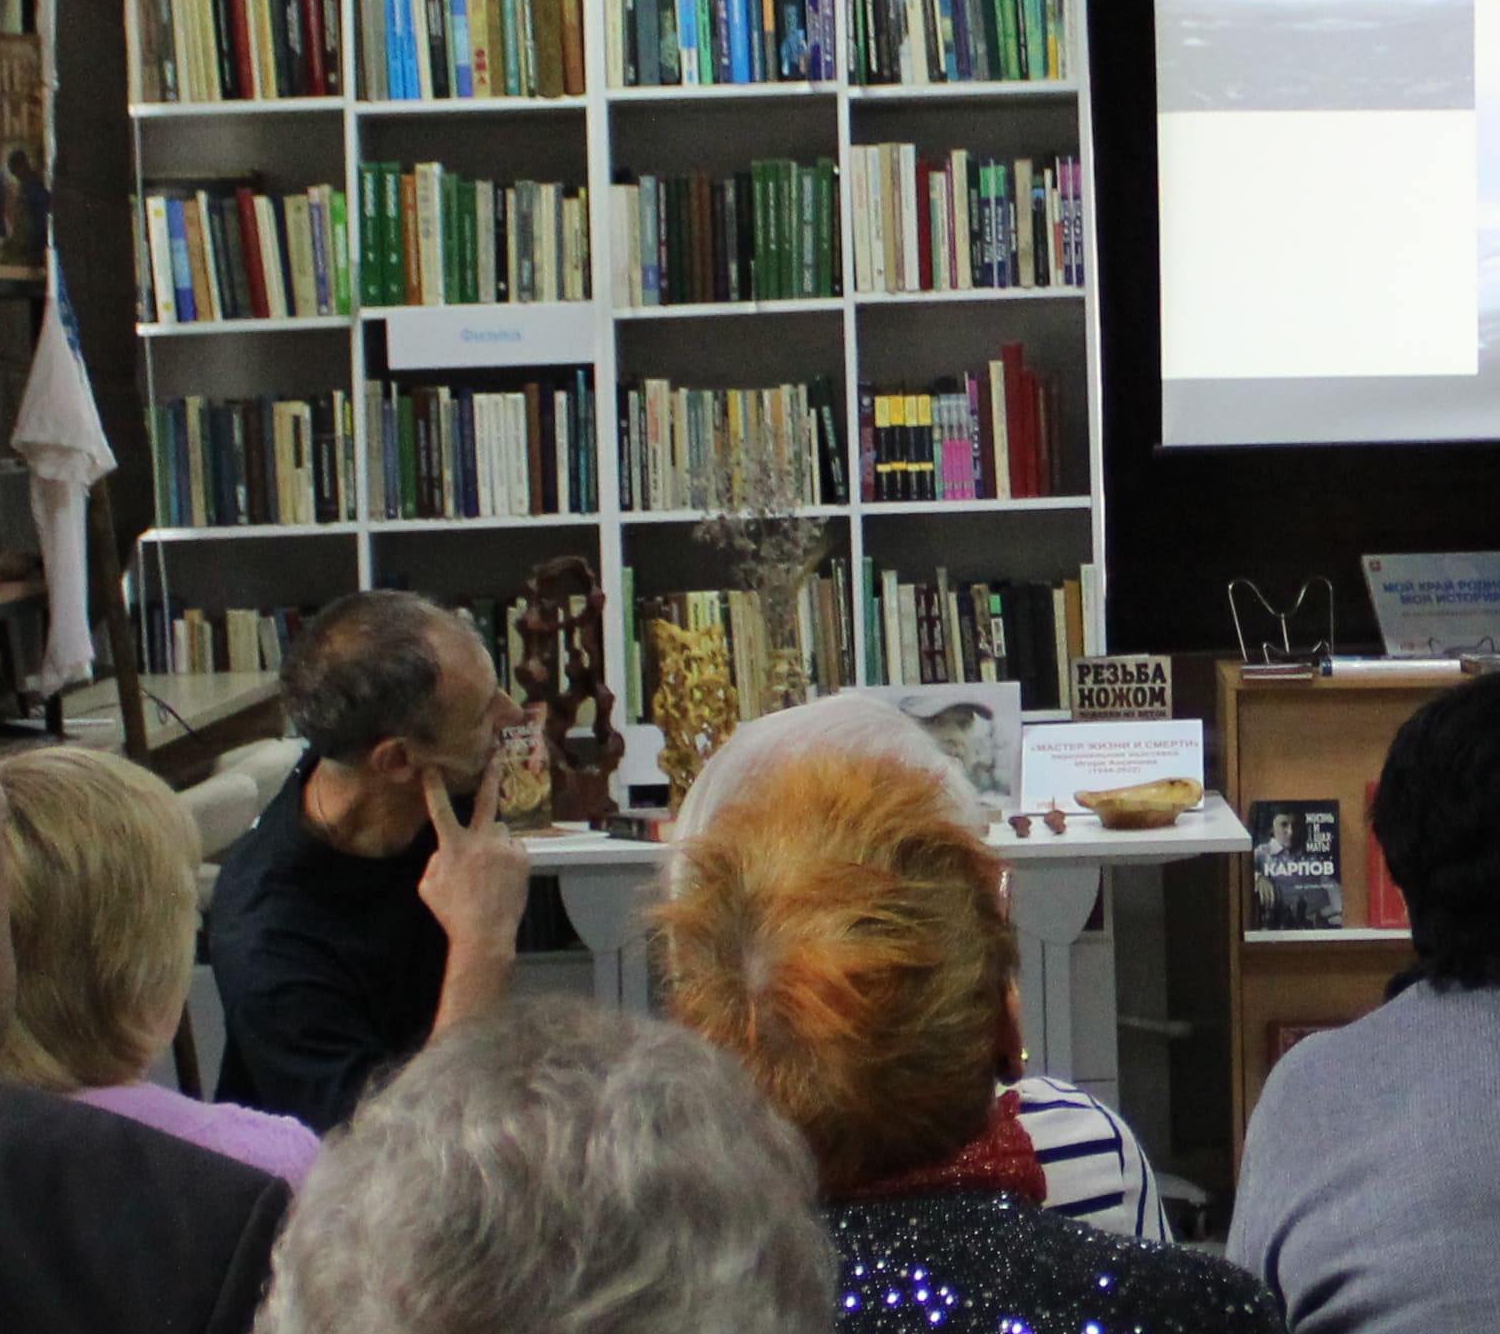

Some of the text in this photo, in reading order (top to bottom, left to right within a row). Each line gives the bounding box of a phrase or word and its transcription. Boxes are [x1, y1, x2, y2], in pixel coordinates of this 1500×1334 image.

[1382, 579, 1414, 593] МОЙ
[1418, 579, 1454, 592] КРАЙ
[1077, 662, 1167, 685] РЕЗЬБА
[1078, 686, 1167, 708] НОЖОМ
[1089, 742, 1130, 750] ЖИЗНИ
[1305, 813, 1334, 824] ЖИЗНЬ
[1306, 842, 1330, 852] МАТЫ
[1264, 861, 1334, 877] КАРПОВ
